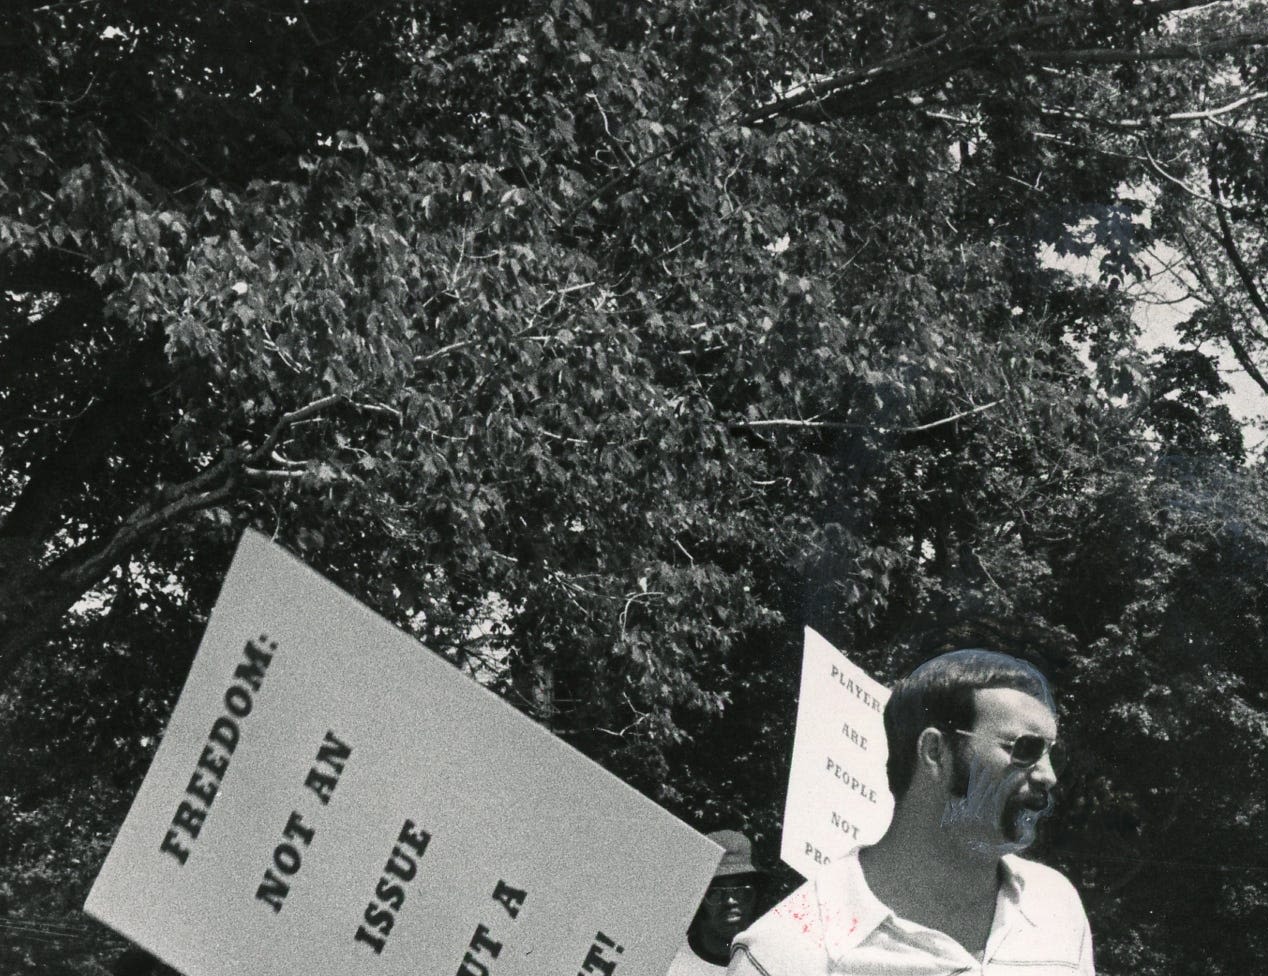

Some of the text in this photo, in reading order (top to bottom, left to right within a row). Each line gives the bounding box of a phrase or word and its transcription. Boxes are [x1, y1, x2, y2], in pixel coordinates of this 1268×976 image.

[159, 633, 279, 866] FREEDOM:
[842, 723, 867, 750] ARE
[826, 757, 877, 803] PEOPLE
[254, 730, 354, 914] NOT AN
[831, 811, 860, 840] NOT
[353, 818, 431, 955] ISSUE
[491, 878, 528, 919] A
